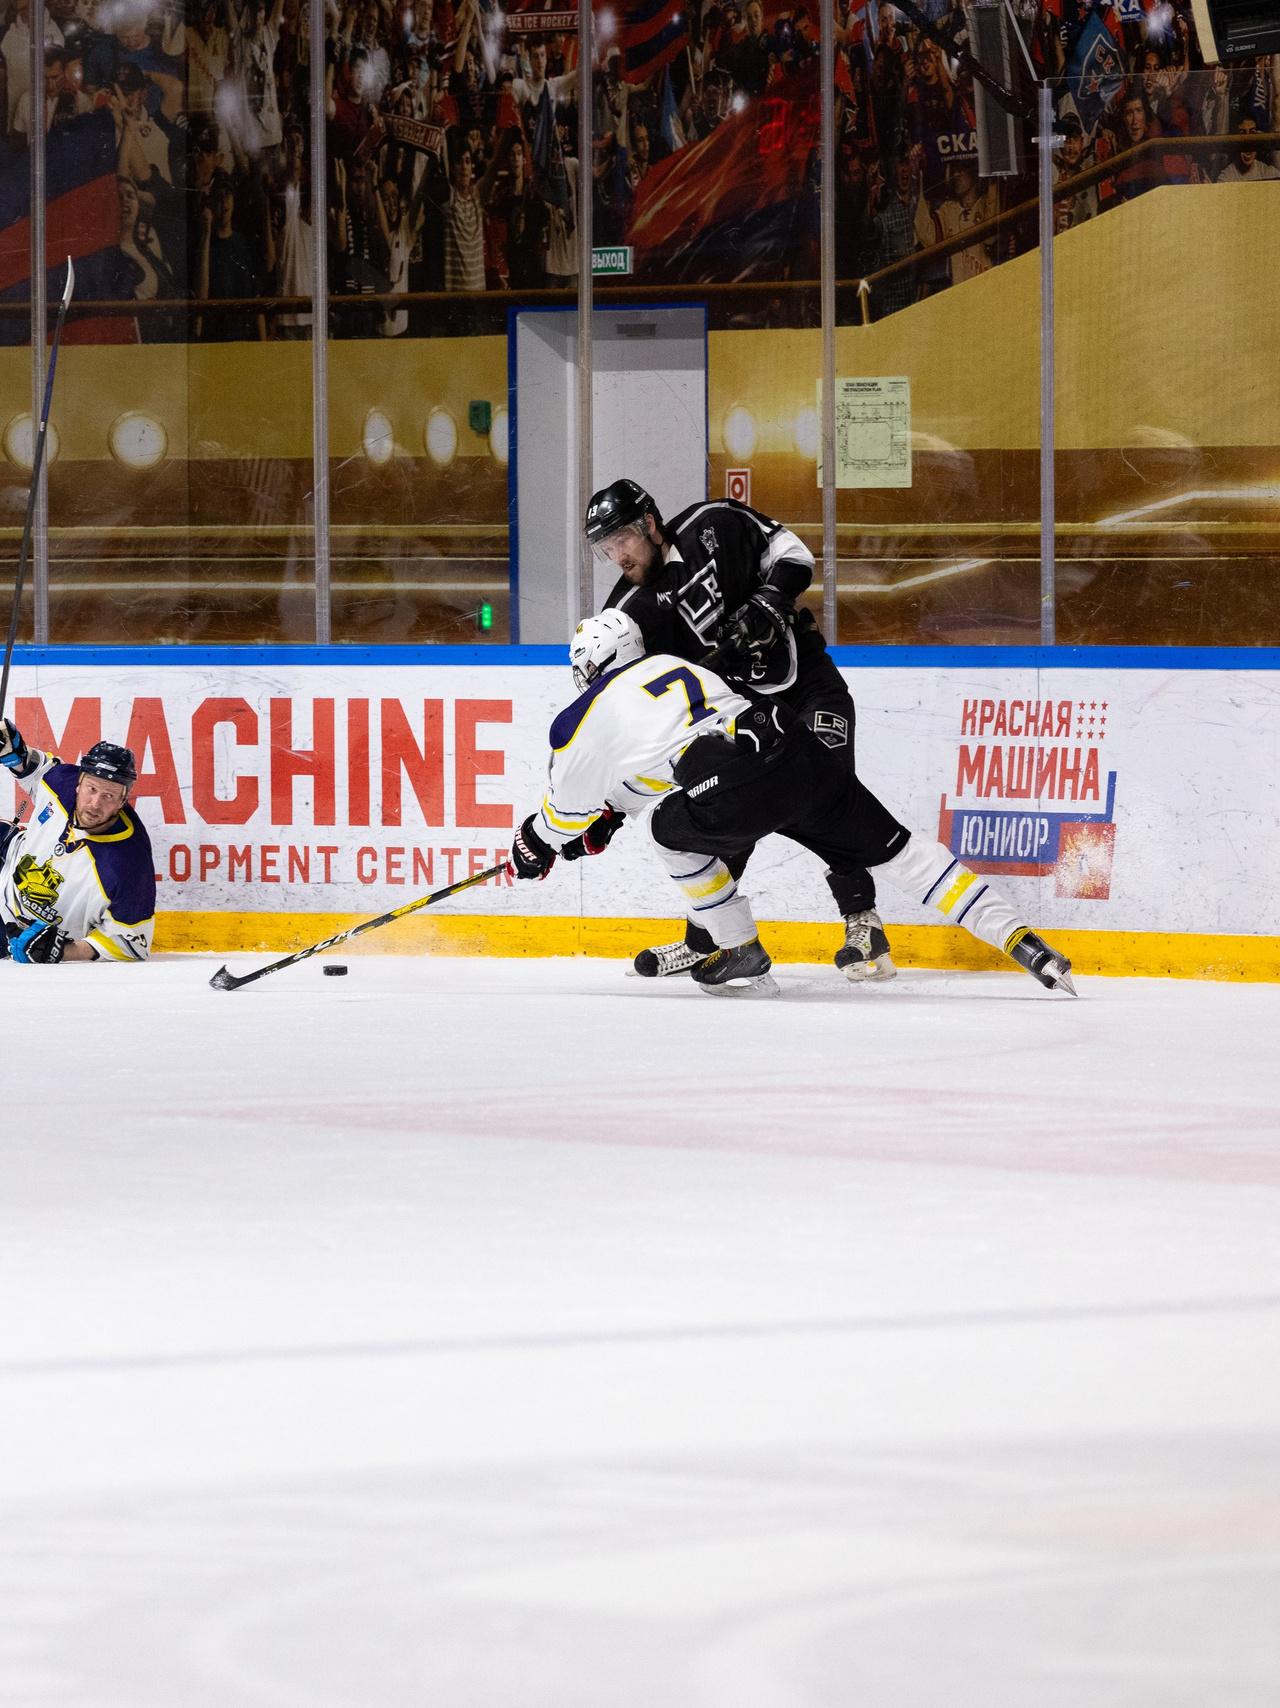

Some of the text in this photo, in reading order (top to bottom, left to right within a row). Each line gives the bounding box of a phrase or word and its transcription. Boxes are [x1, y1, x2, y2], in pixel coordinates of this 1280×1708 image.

[936, 131, 978, 154] СКА
[592, 252, 625, 270] ВЫХОД
[587, 504, 599, 519] 13
[641, 664, 719, 728] 7
[816, 714, 846, 733] LR
[961, 699, 1073, 738] КРАСНАЯ
[15, 697, 514, 828] MACHINE
[956, 745, 1099, 800] МАШИНА
[960, 816, 1049, 858] ЮНИОР
[155, 844, 338, 884] OPMENT
[357, 846, 514, 887] CENTER
